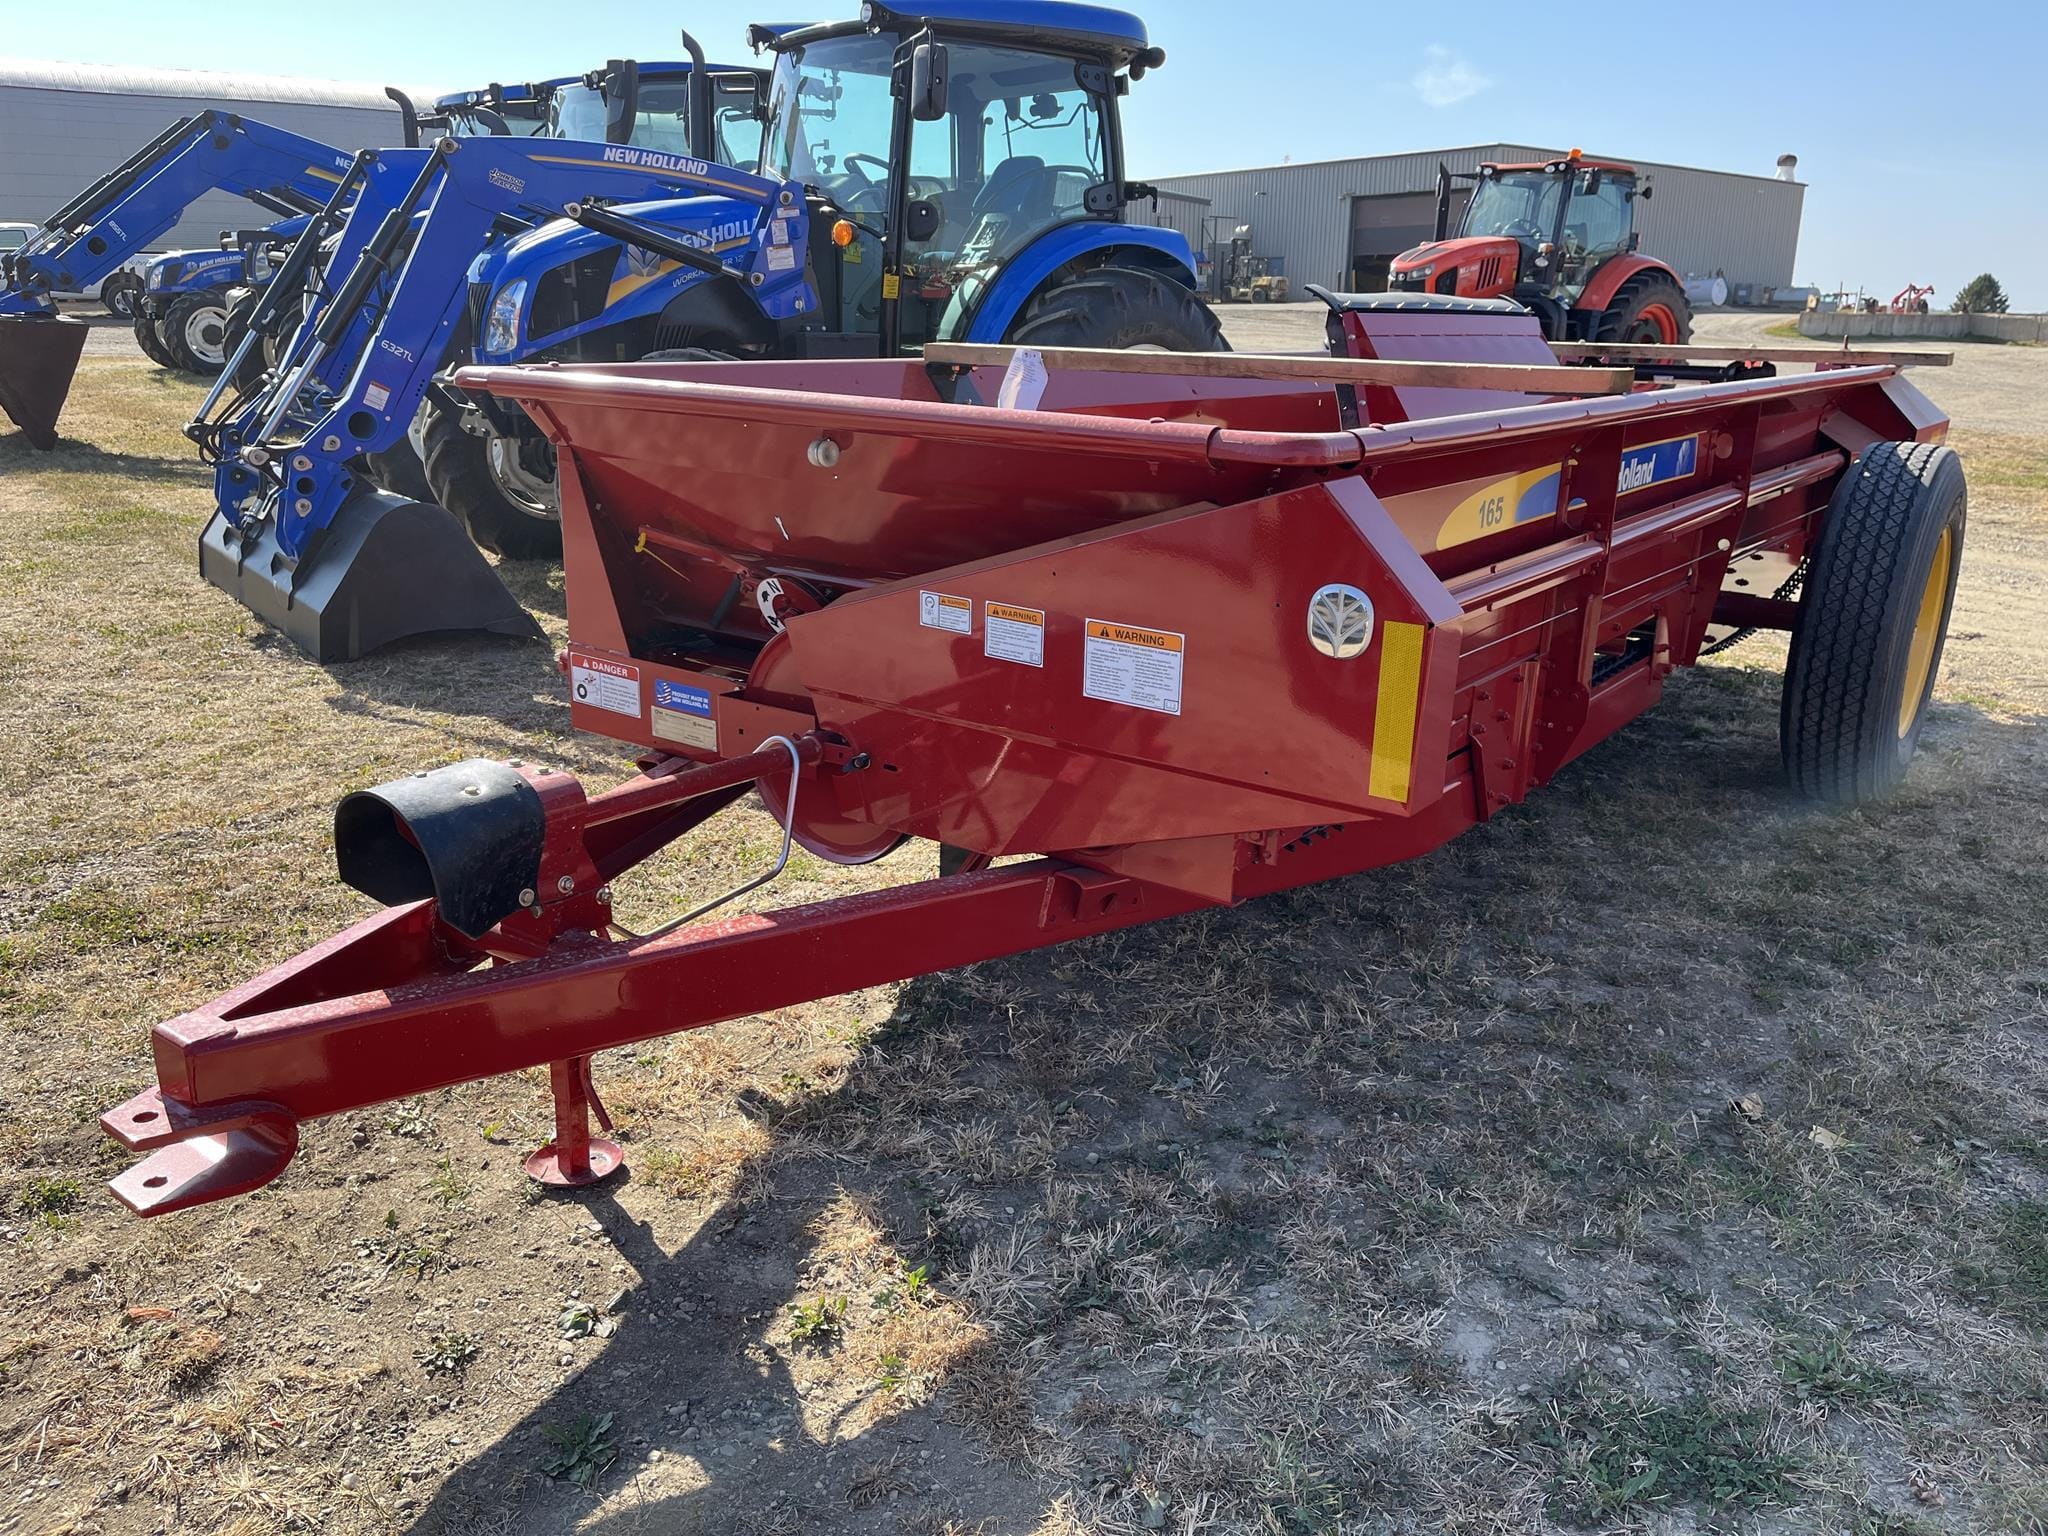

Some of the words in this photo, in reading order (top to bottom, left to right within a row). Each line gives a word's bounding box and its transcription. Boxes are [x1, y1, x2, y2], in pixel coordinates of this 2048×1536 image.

[335, 156, 353, 169] NE
[603, 147, 640, 163] NEW
[641, 151, 708, 176] HOLLAND
[489, 168, 525, 187] JOHNSON
[489, 175, 523, 194] TRACTOR
[381, 340, 414, 363] 632TL
[1479, 496, 1504, 528] 165
[947, 599, 968, 608] WARNING
[1001, 609, 1038, 622] WARNING
[1115, 629, 1165, 647] WARNING
[592, 661, 628, 677] DANGER
[671, 690, 690, 700] PROUDLY
